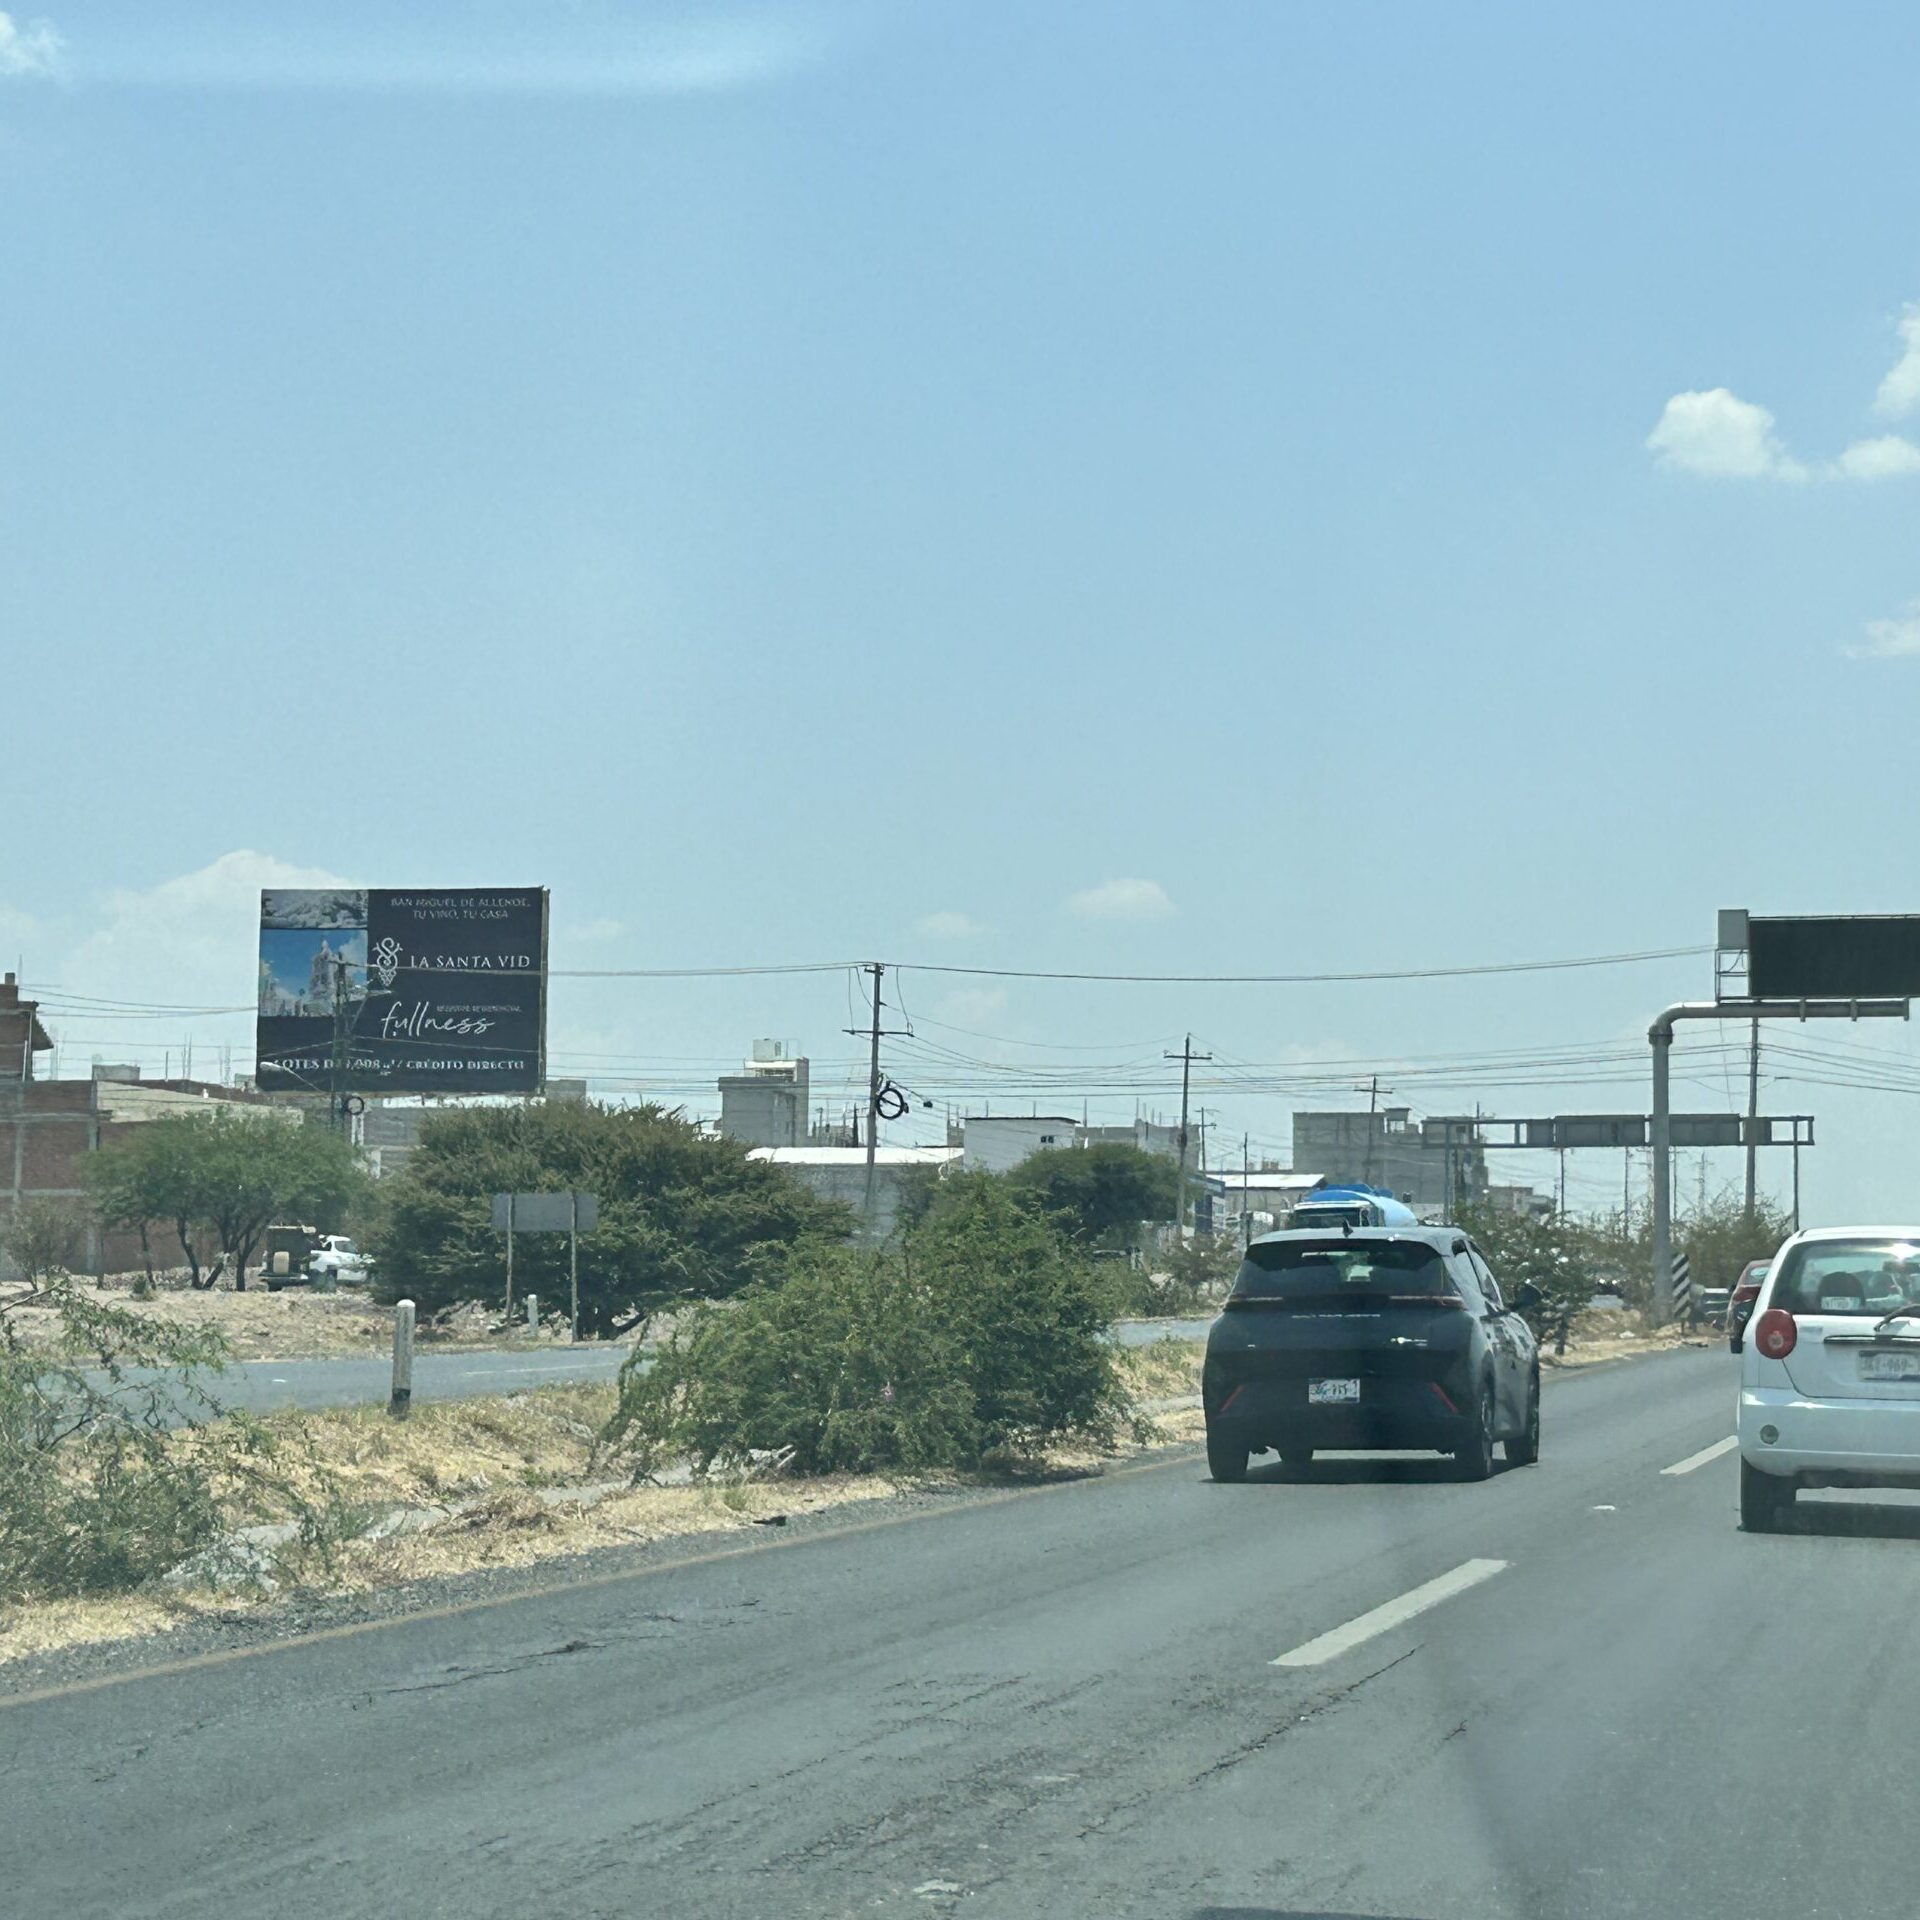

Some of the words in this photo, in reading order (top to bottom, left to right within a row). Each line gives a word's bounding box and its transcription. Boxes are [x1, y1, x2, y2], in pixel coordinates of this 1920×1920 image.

[460, 898, 474, 907] DE
[413, 910, 426, 919] TU
[463, 910, 477, 919] TU
[480, 910, 508, 919] CASA
[411, 955, 429, 968] LA
[436, 955, 491, 968] SANTA
[498, 955, 530, 968] VID
[381, 1001, 495, 1039] fullness
